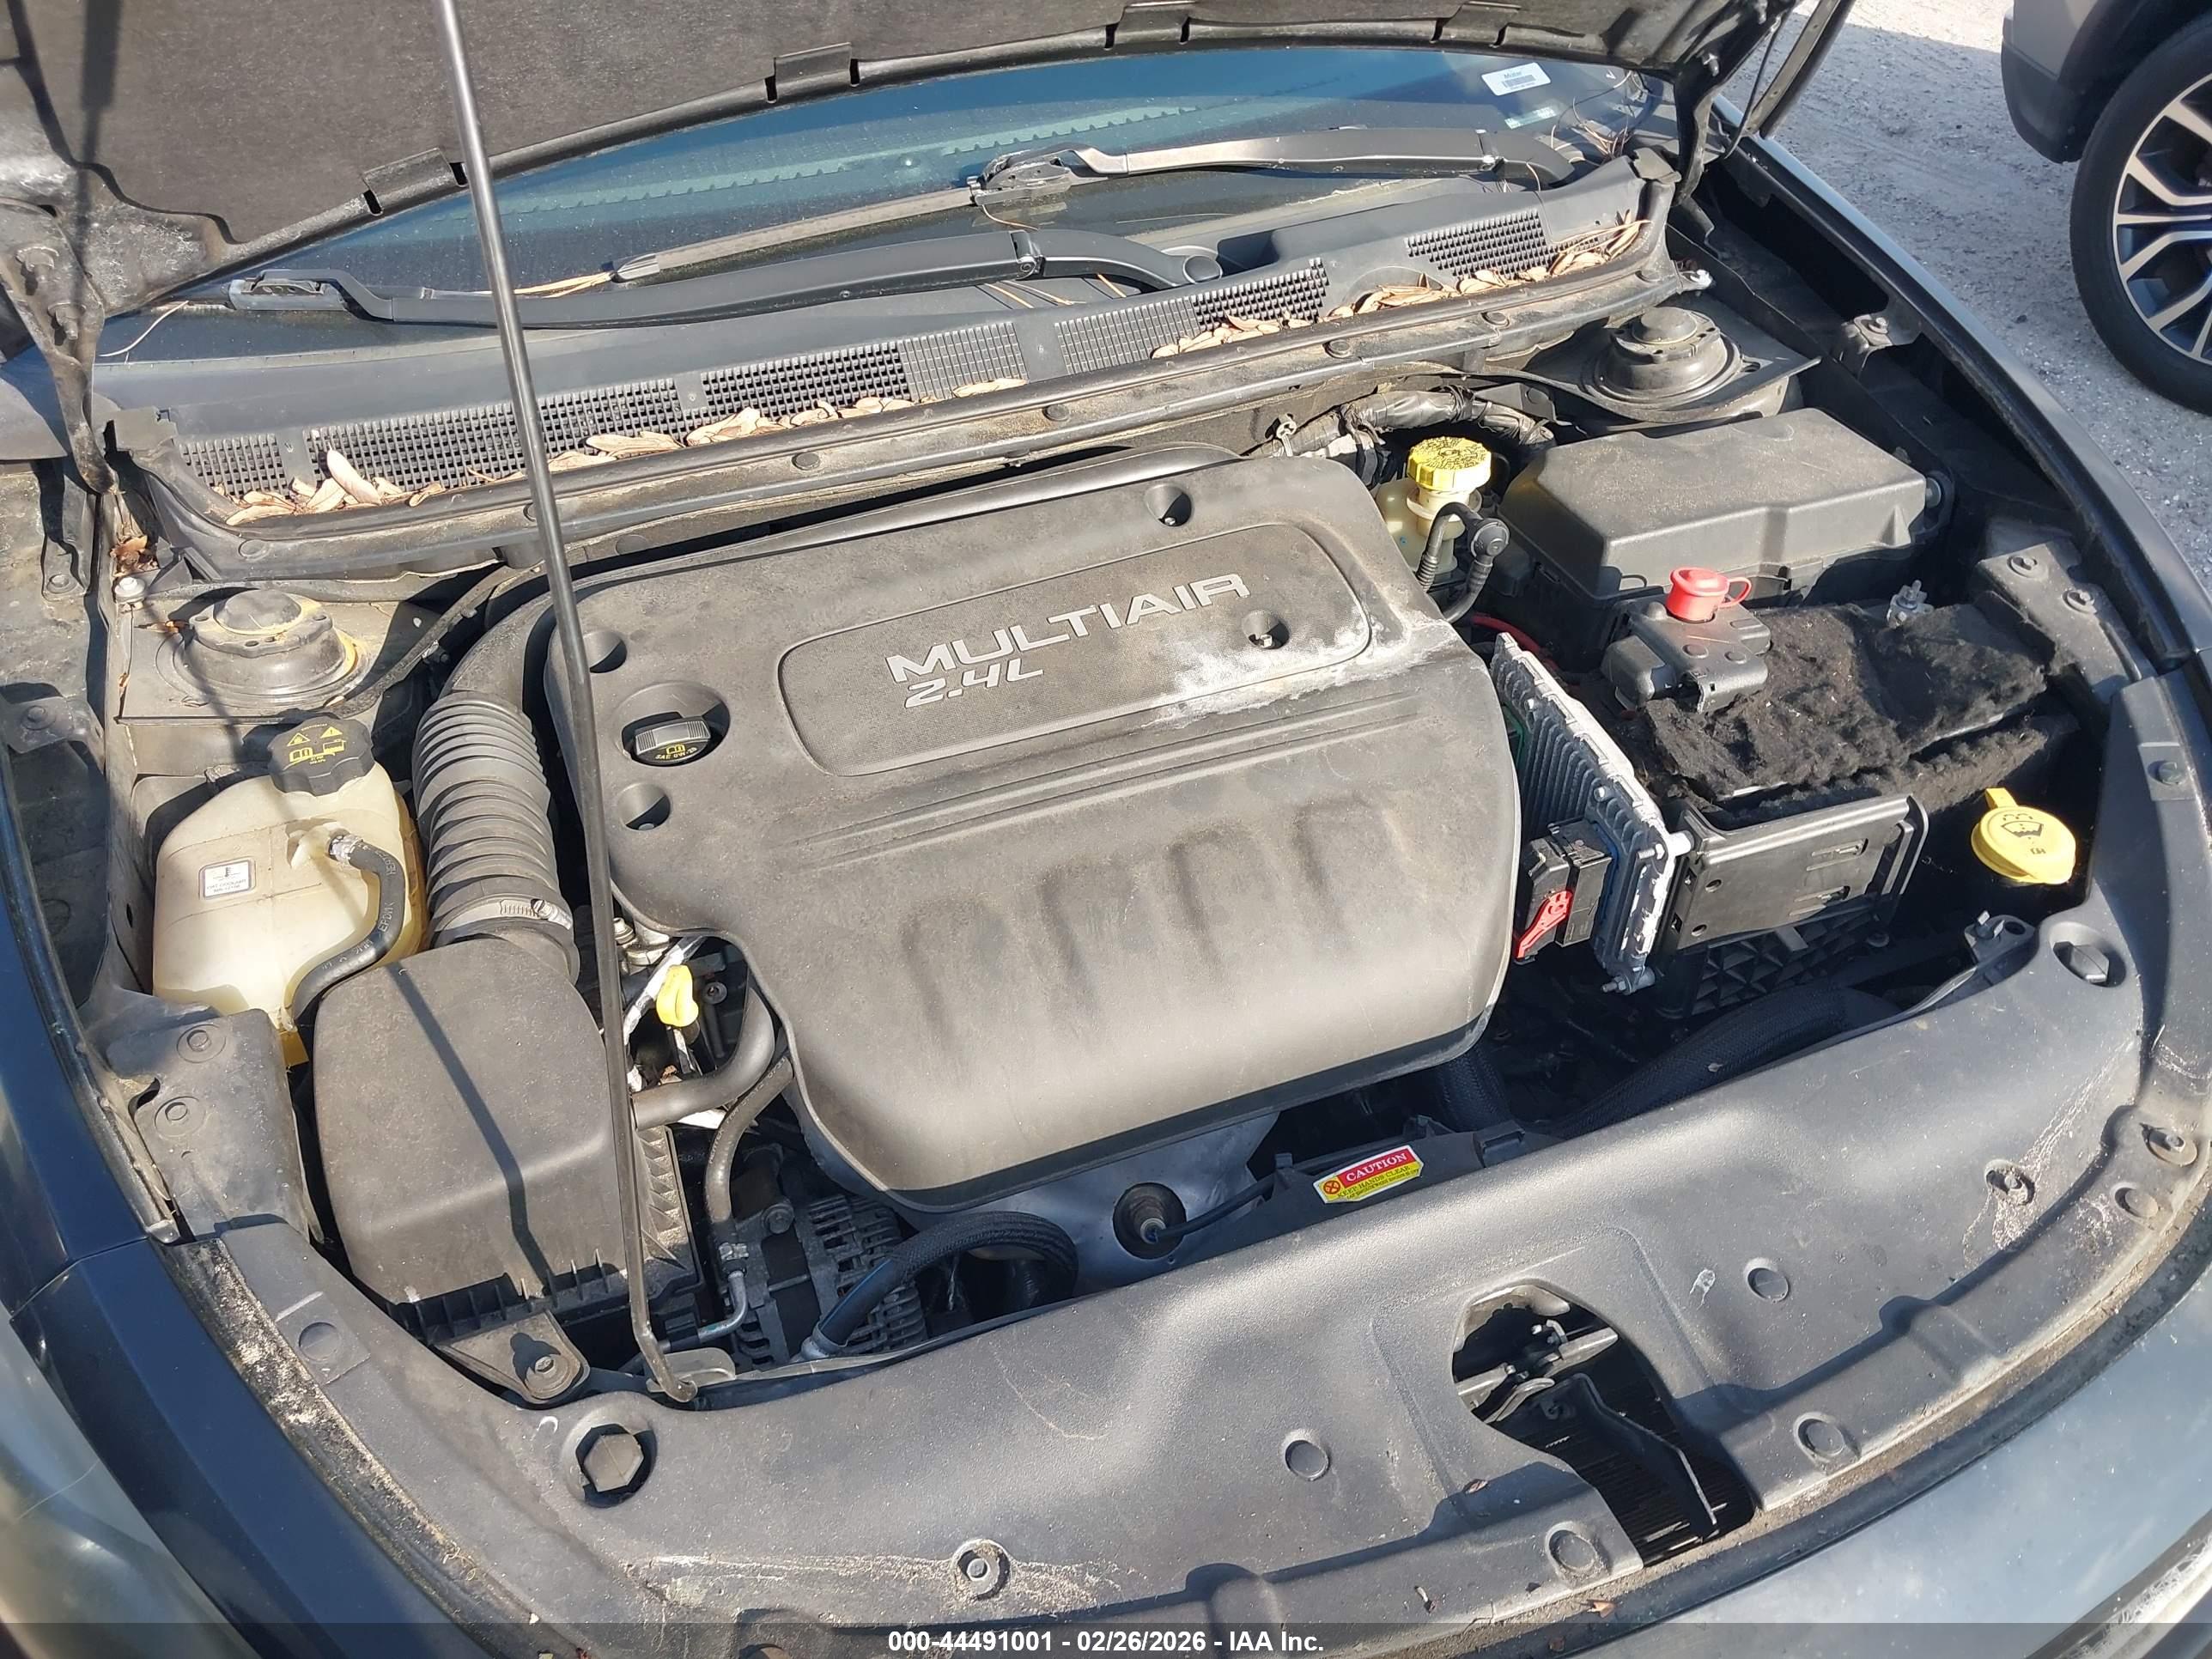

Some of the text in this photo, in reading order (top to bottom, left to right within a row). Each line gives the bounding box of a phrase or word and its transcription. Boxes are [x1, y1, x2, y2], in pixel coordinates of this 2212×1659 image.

[885, 573, 1251, 684] MULTIAIR
[904, 657, 1044, 708] 2.4L
[1338, 1185, 1358, 1198] KEEP
[1359, 1174, 1384, 1189] HANDS
[1386, 1165, 1410, 1179] CLEAR
[1346, 1153, 1407, 1182] CAUTION
